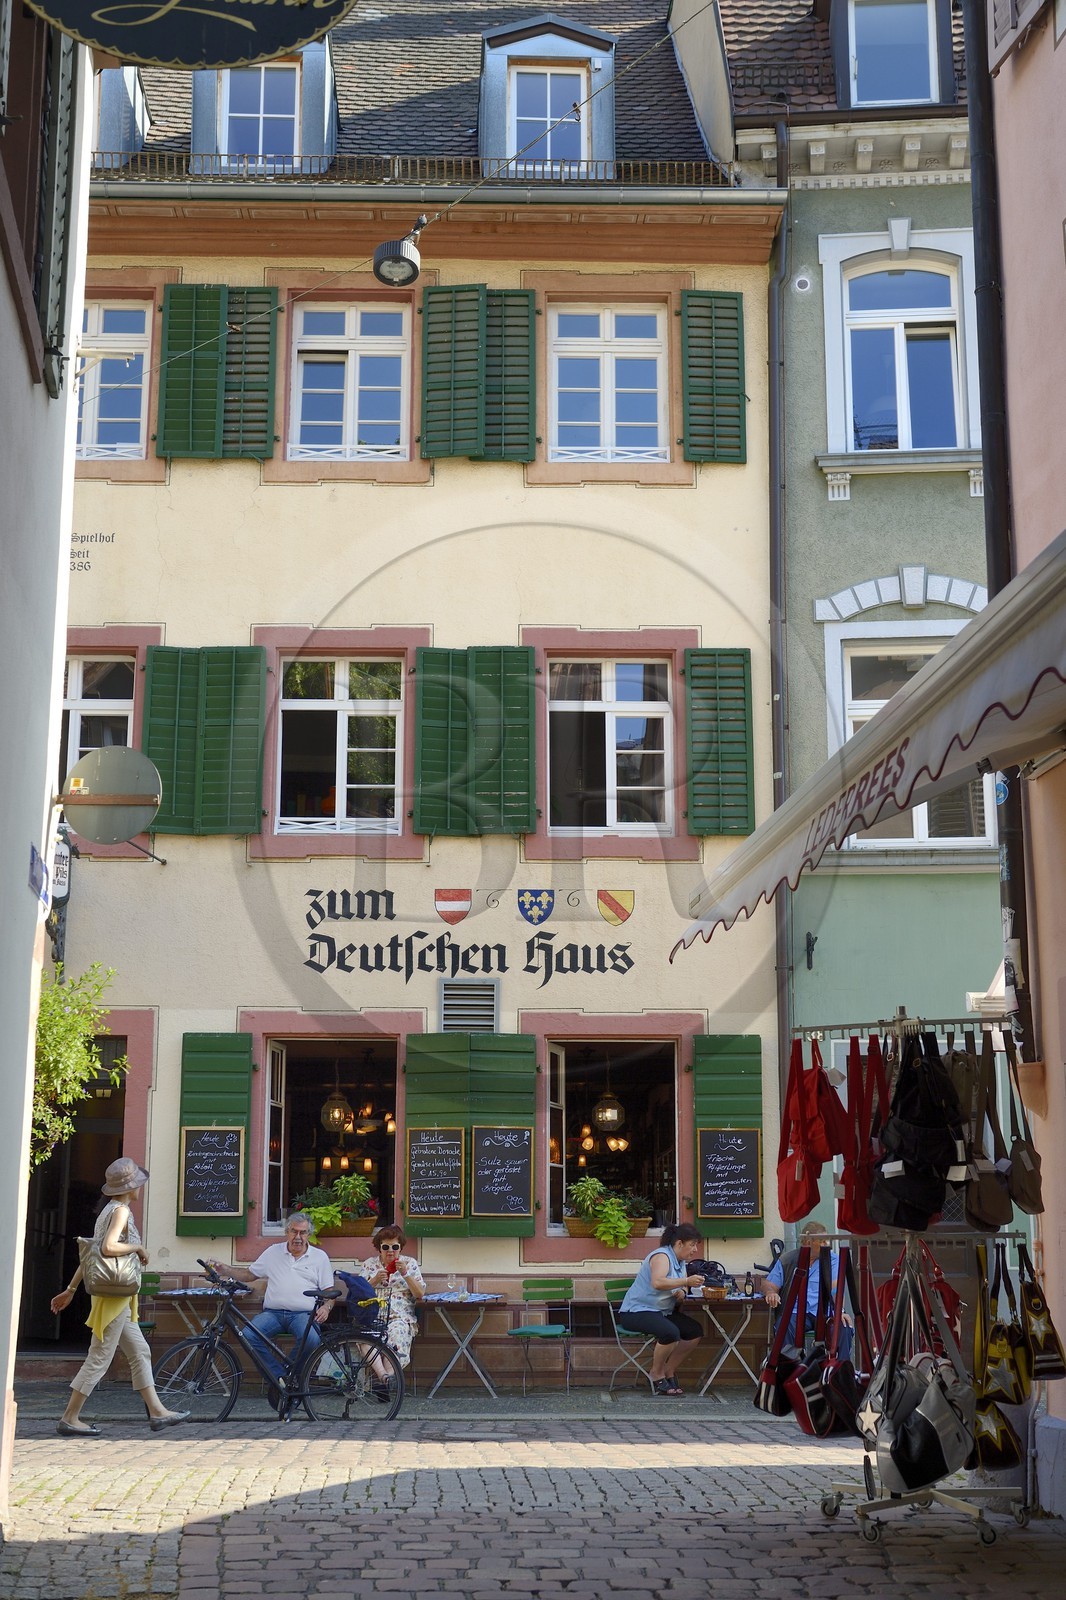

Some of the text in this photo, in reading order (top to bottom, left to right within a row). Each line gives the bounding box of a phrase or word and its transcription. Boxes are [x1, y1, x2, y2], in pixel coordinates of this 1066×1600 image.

[71, 532, 115, 544] Spielhof
[70, 561, 91, 572] 386
[304, 888, 397, 930] zum
[522, 930, 636, 990] Haus
[200, 1131, 220, 1143] Heute
[420, 1131, 444, 1143] Heute
[493, 1131, 519, 1142] Heute
[705, 1153, 737, 1163] Frische
[492, 1174, 507, 1183] mit
